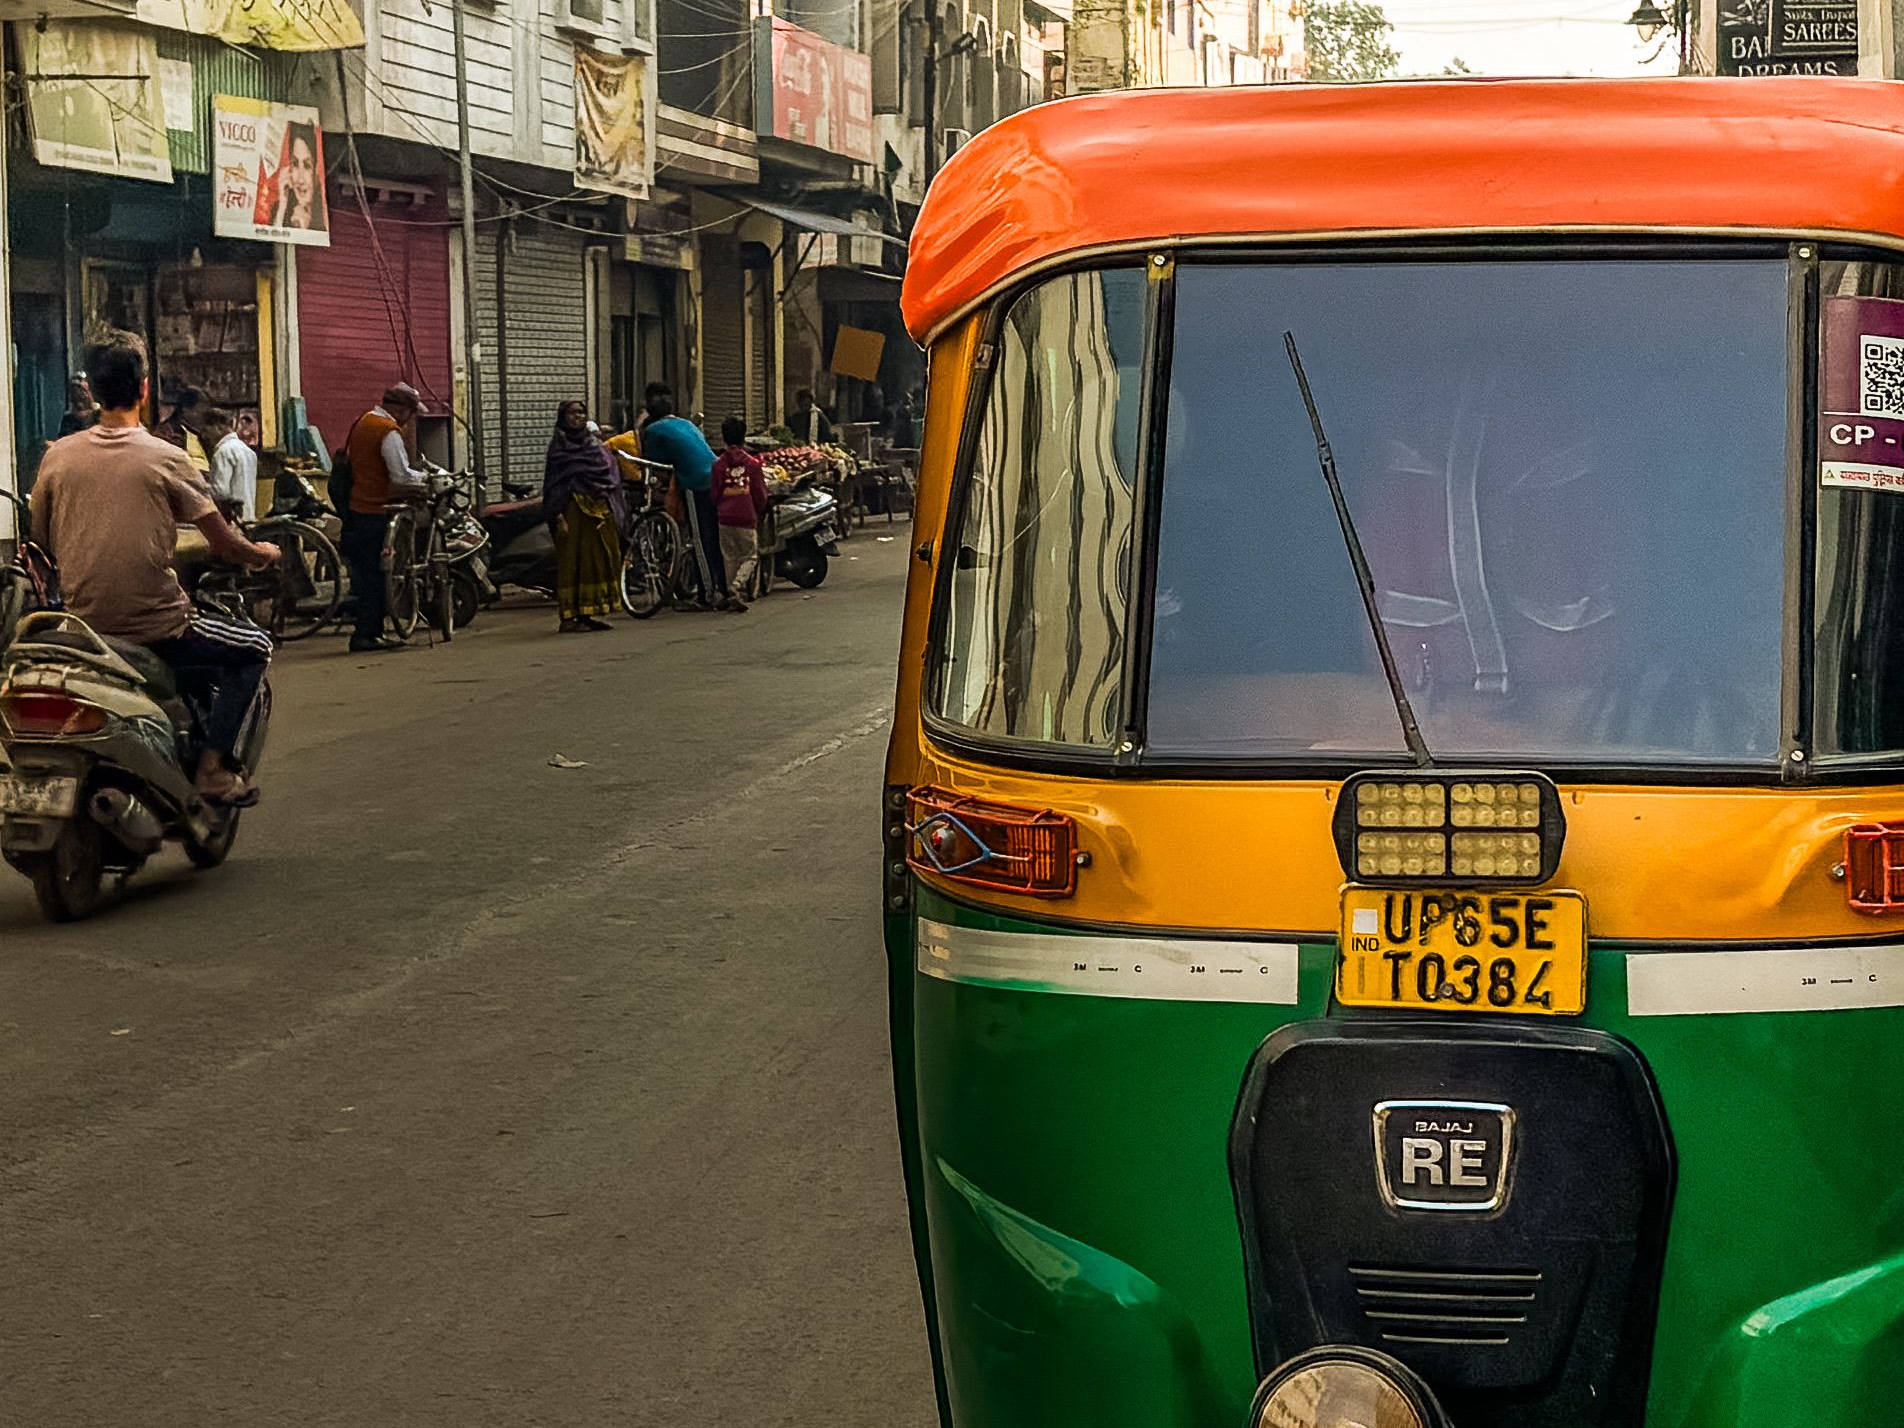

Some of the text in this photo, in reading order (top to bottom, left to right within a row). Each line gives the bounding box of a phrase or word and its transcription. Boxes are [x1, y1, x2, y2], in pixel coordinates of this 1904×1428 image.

[1829, 423, 1875, 445] CP
[1383, 892, 1557, 950] UP65E
[1350, 936, 1380, 952] IND
[1382, 949, 1554, 1010] T0384
[1415, 1120, 1474, 1133] BAJAJ
[1401, 1136, 1488, 1187] RE
